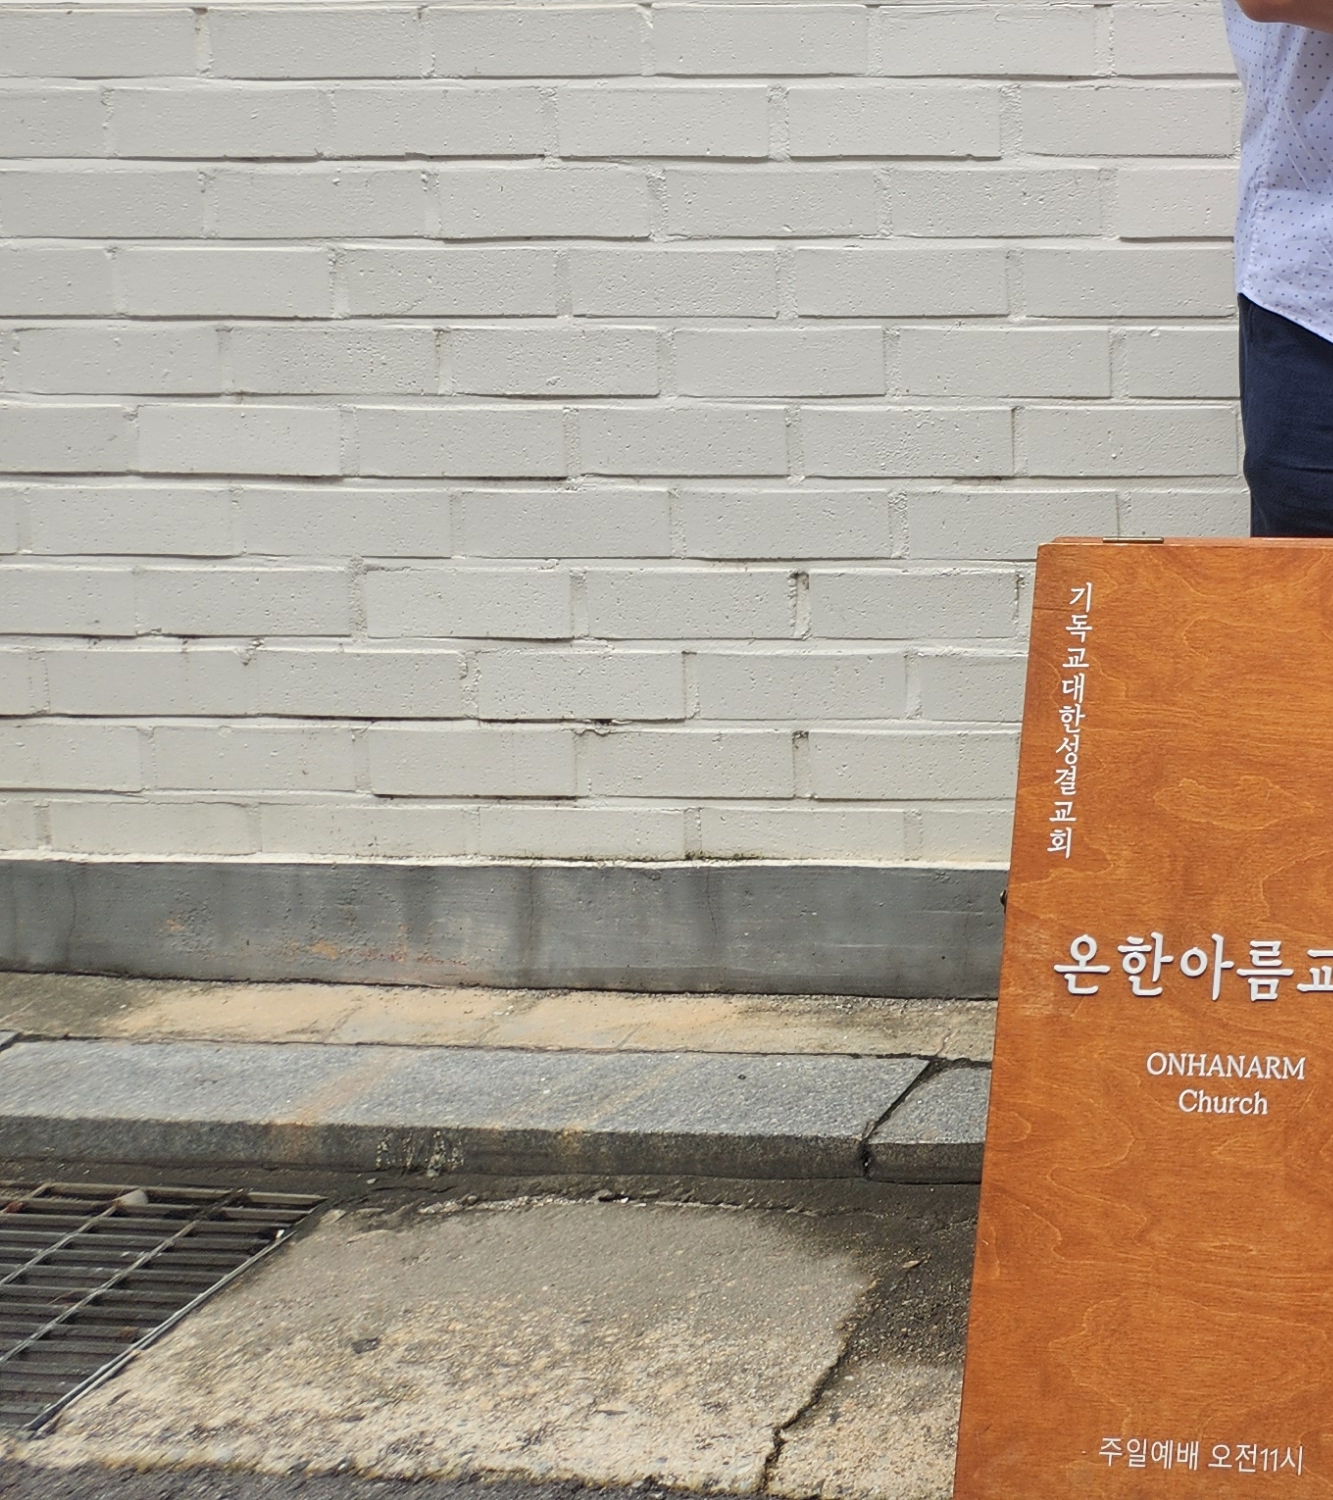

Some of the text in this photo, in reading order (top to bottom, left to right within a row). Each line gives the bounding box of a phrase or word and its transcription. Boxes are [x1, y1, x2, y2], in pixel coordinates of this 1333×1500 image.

[1046, 581, 1093, 859] 기독교대한성결교회
[1145, 1051, 1307, 1081] ONHANARM
[1177, 1088, 1269, 1116] Church
[1098, 1437, 1304, 1476] 주일예배 오전11시
